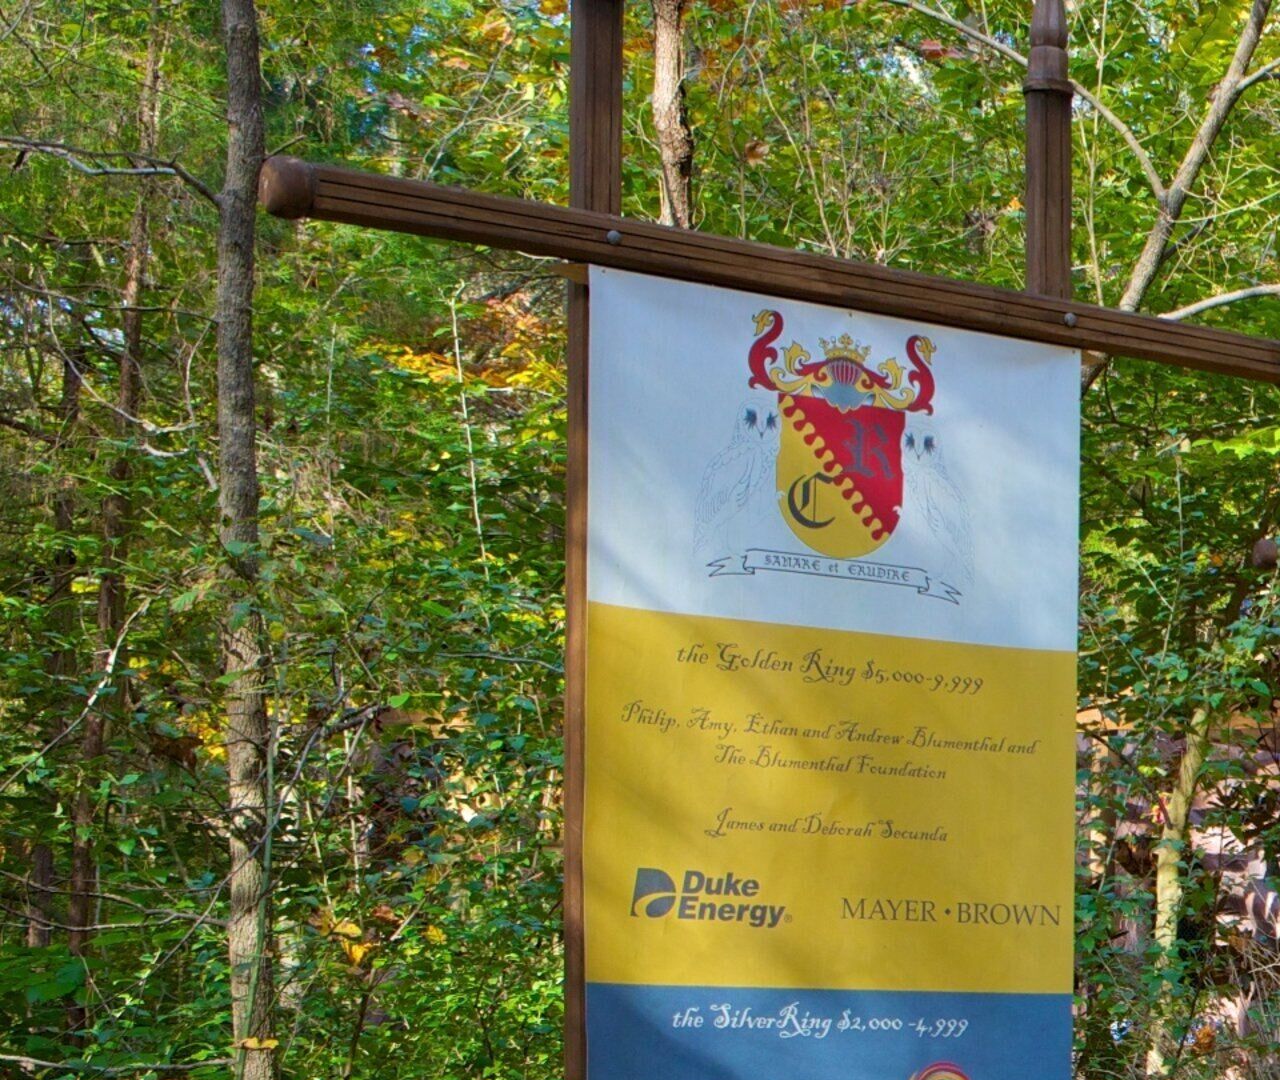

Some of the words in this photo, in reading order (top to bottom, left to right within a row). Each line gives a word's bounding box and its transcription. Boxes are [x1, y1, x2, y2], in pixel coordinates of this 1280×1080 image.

[787, 472, 836, 530] C
[829, 563, 838, 573] et
[848, 566, 911, 582] ERUDIRE
[676, 643, 709, 665] the
[716, 642, 793, 672] Golden
[800, 649, 856, 686] Ring
[743, 712, 798, 737] Ethan
[802, 724, 837, 739] and
[835, 720, 905, 744] Andrew
[906, 726, 1005, 752] Blumenthal
[1008, 739, 1041, 755] and
[714, 744, 746, 765] The
[749, 746, 852, 772] Blumenthal
[856, 755, 947, 779] Foundation
[704, 808, 764, 838] James
[768, 818, 803, 833] and
[802, 812, 876, 837] Deborah
[878, 819, 948, 842] Secunda
[681, 870, 760, 896] Duke
[677, 895, 786, 928] Energy
[840, 897, 937, 922] MAYER
[956, 902, 1061, 926] BROWN
[672, 1006, 704, 1029] the
[837, 1008, 903, 1033] $2,000
